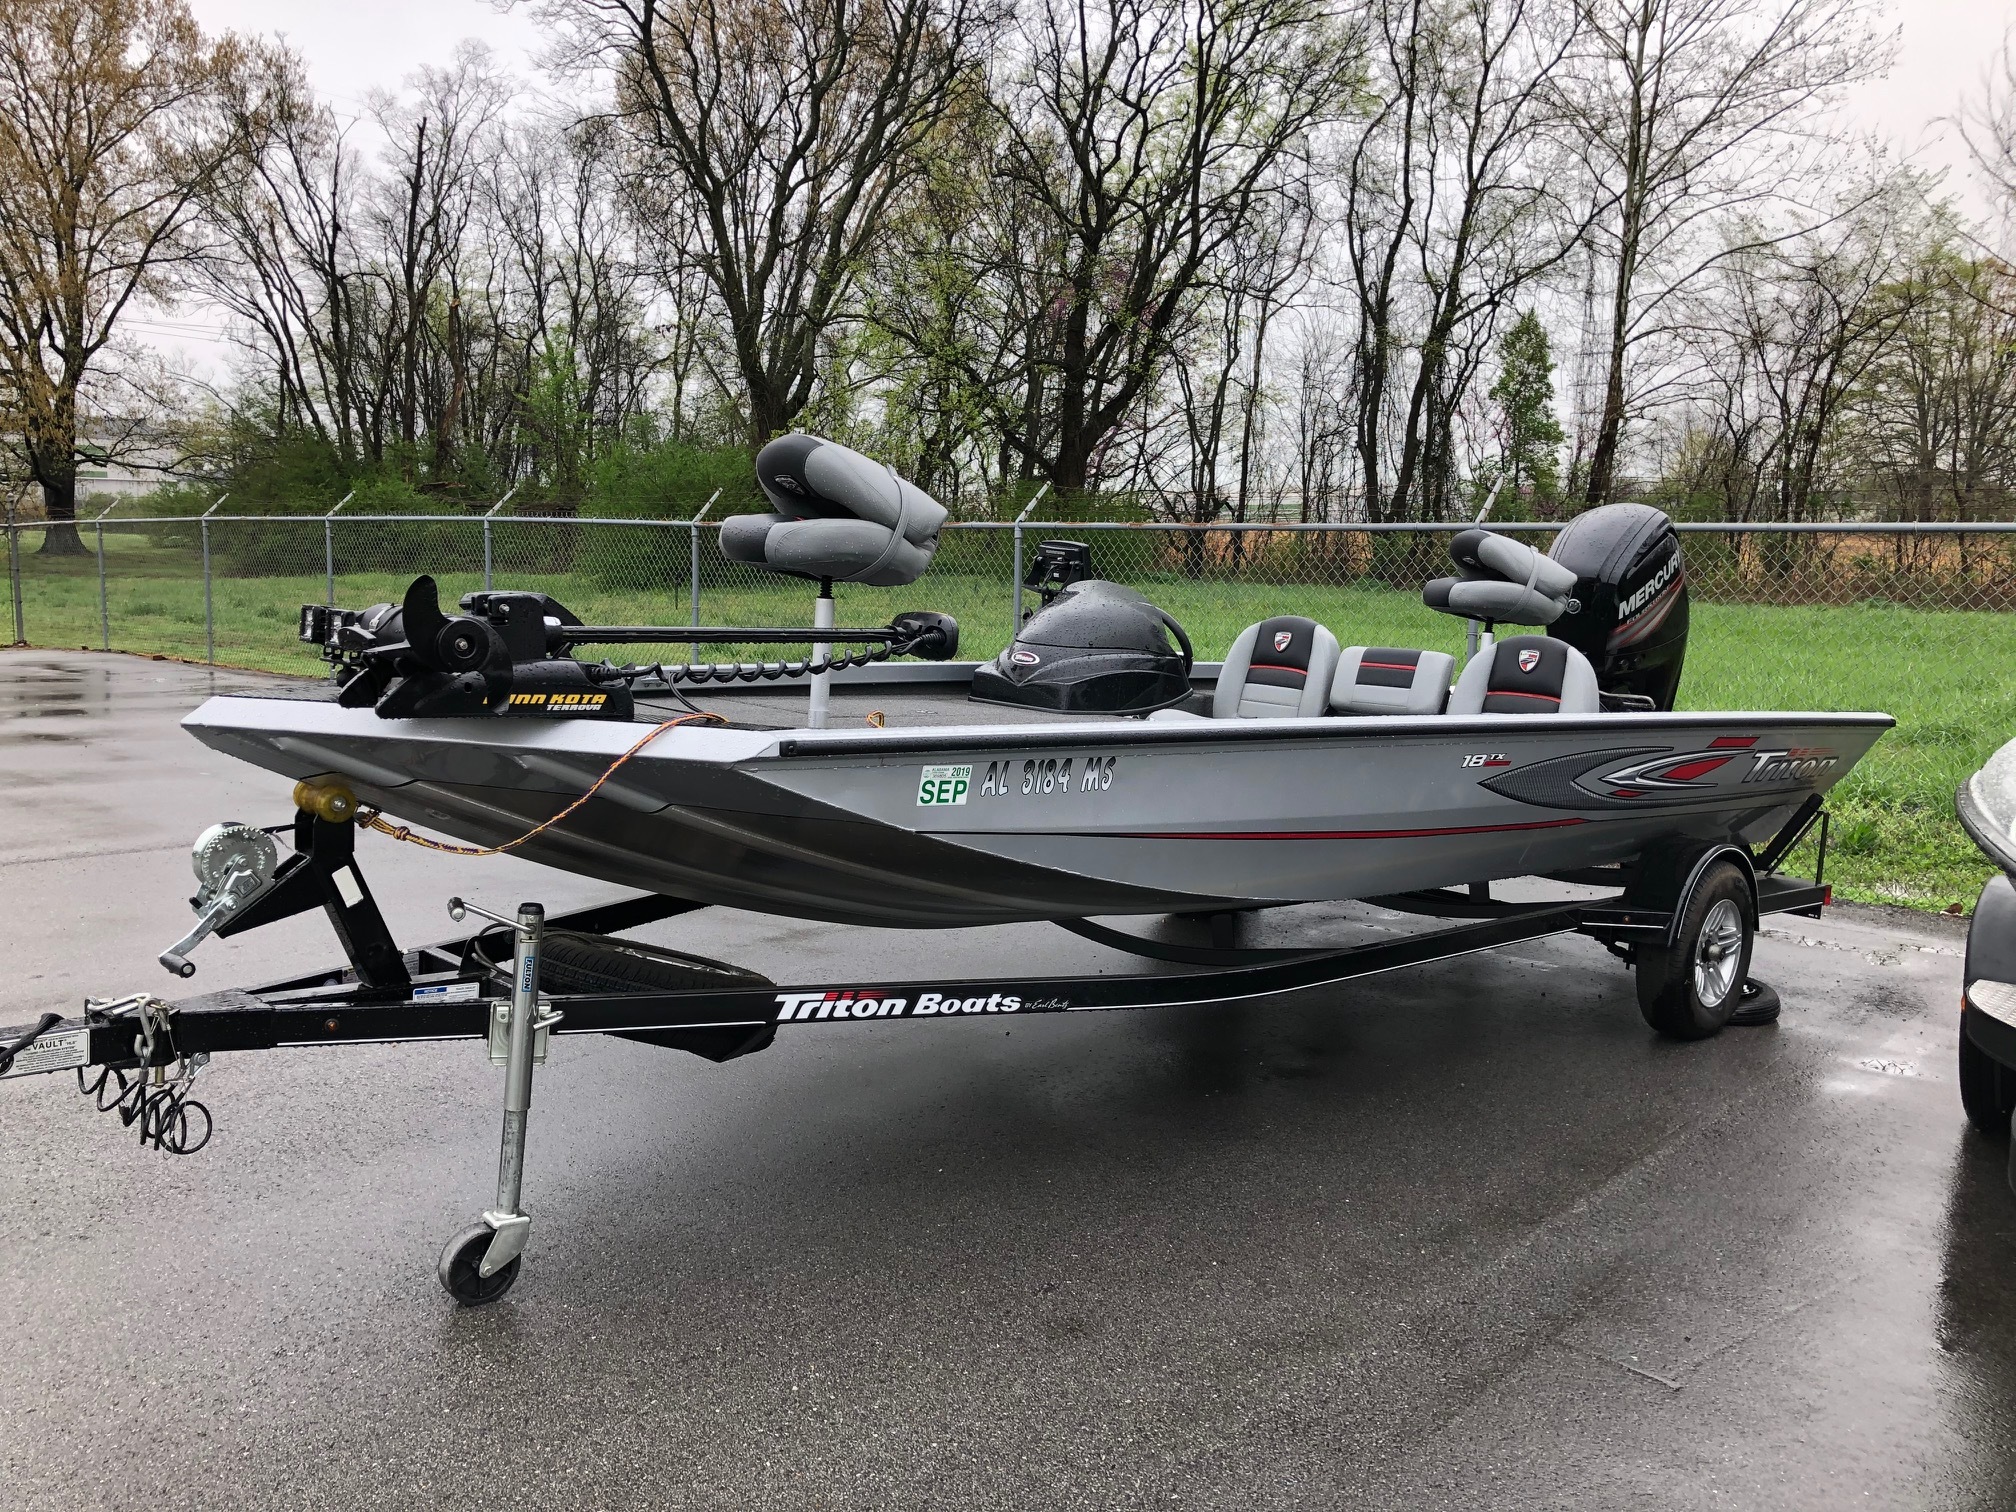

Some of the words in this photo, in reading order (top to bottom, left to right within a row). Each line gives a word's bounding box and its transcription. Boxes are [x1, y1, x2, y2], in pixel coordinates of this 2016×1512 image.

[550, 693, 608, 705] KOTA
[951, 767, 970, 777] 2019
[980, 760, 1011, 797] AL
[1021, 757, 1073, 796] 3184
[1080, 755, 1117, 793] MS
[919, 779, 968, 804] SEP
[523, 959, 533, 990] FULTON
[774, 992, 907, 1020] Triton
[912, 993, 1022, 1015] Boats
